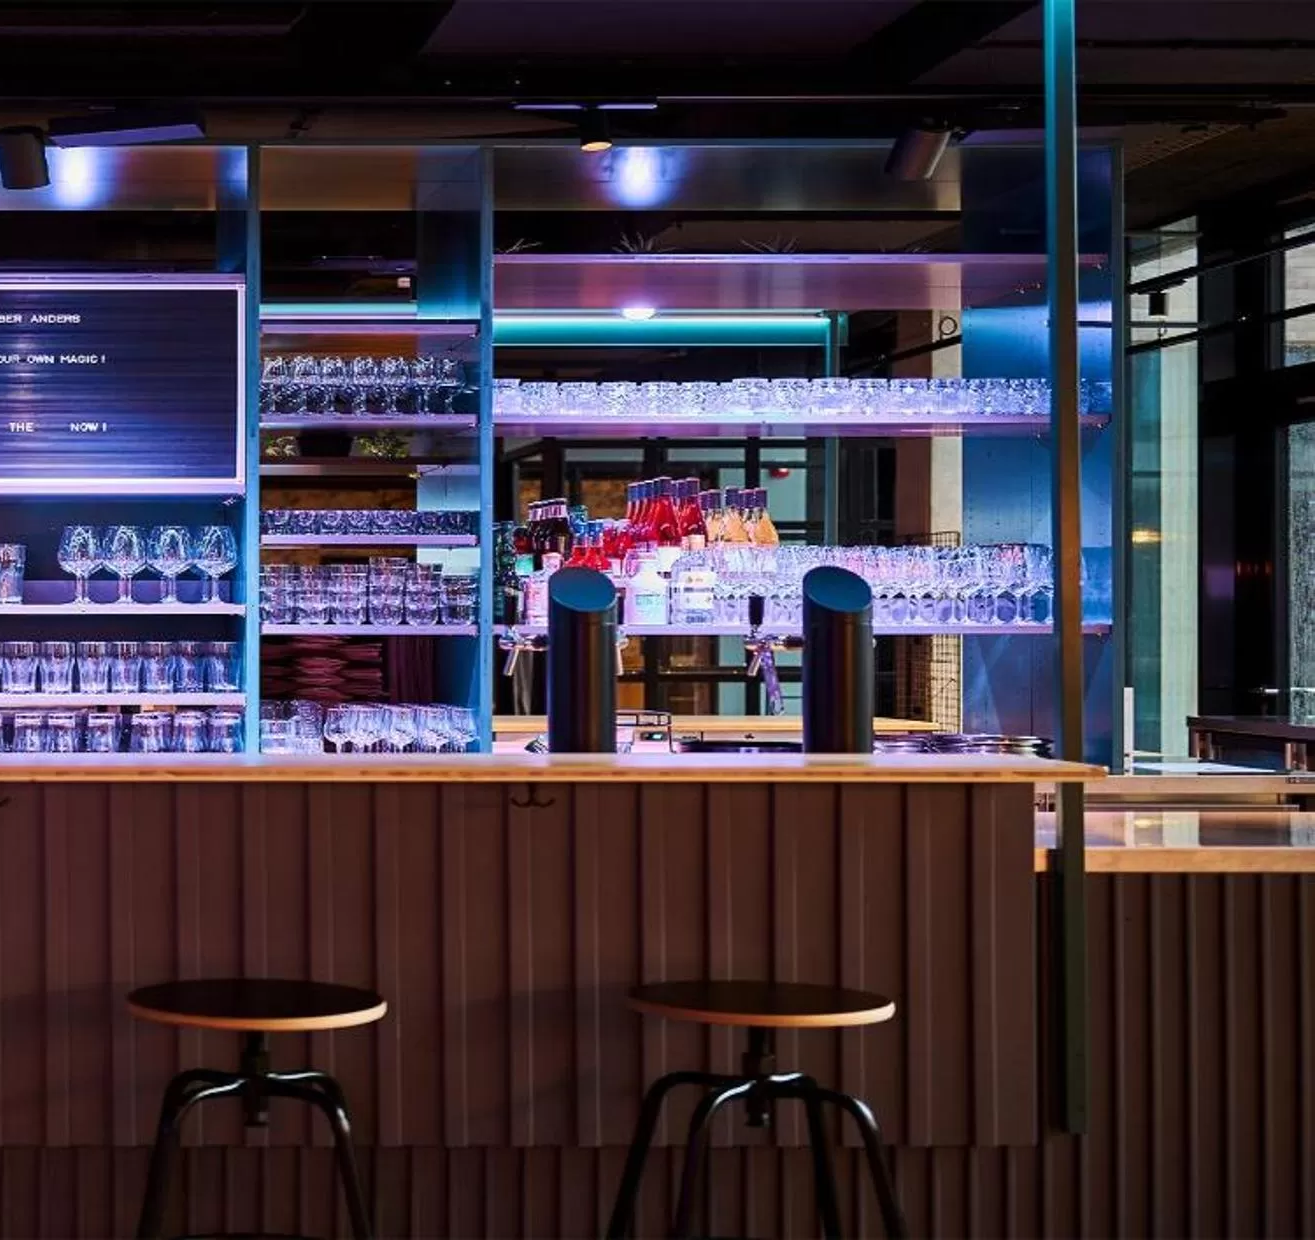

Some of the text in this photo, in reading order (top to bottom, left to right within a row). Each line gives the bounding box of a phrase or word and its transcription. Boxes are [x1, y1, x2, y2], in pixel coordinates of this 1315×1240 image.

[30, 314, 81, 324] ANDERS
[26, 354, 55, 364] OWN
[9, 422, 35, 432] THE
